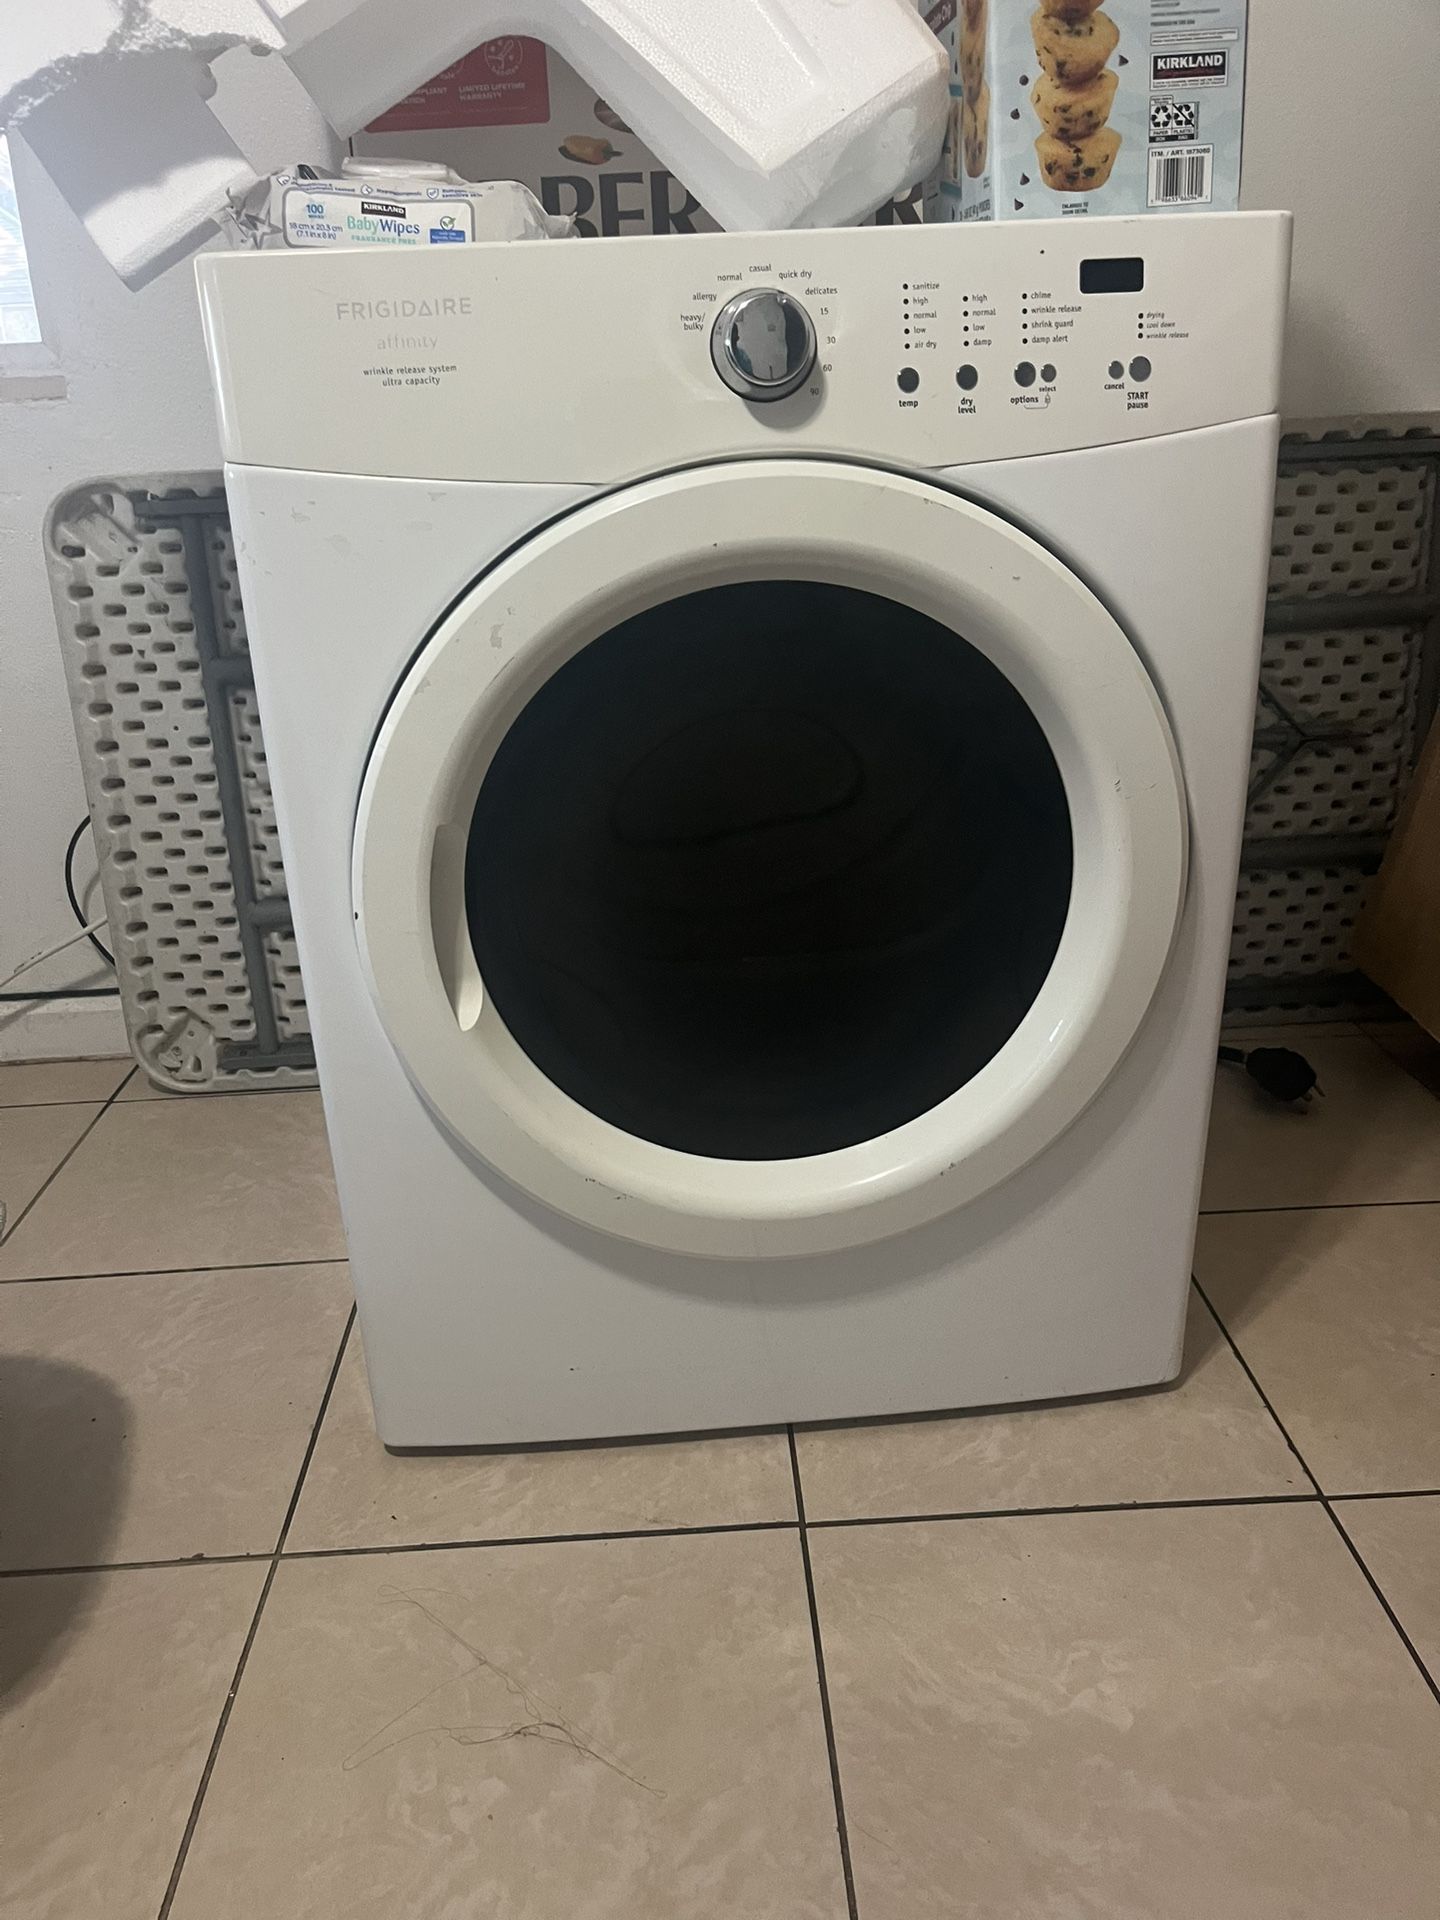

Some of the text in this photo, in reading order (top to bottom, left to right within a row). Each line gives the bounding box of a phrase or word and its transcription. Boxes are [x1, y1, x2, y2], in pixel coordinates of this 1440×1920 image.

[1157, 54, 1223, 70] KIRKLAND
[305, 204, 324, 214] 100
[363, 203, 405, 214] KIRKLAND
[748, 264, 772, 272] casual
[717, 273, 743, 281] normal
[778, 270, 812, 280] quick dry
[912, 282, 940, 290] sanitize
[805, 287, 838, 296] delicates
[1031, 291, 1052, 299] chime
[692, 292, 717, 302] allergy
[912, 296, 928, 306] high
[972, 294, 988, 303] high
[336, 297, 473, 320] FRIGIDAIRE
[820, 307, 829, 315] 15
[972, 308, 997, 316] normal
[1031, 305, 1082, 314] wrinkle release
[680, 312, 706, 323] heavy/
[913, 311, 937, 319] normal
[1146, 311, 1165, 319] drying
[683, 322, 704, 331] bulky
[972, 323, 986, 331] low
[1031, 320, 1074, 330] shrink guard
[913, 326, 927, 334] low
[1031, 334, 1068, 345] damp alert
[1146, 331, 1189, 339] wrinkle release
[377, 334, 439, 351] affinity
[826, 336, 837, 345] 30
[926, 340, 937, 350] dry
[973, 338, 992, 347] damp
[363, 364, 457, 376] wrinkle release system
[822, 364, 833, 372] 60
[382, 376, 441, 387] ultra capacity
[1104, 382, 1125, 391] cancel
[810, 387, 820, 396] 90
[1127, 391, 1149, 401] START
[898, 399, 919, 408] temp
[960, 397, 973, 406] dry
[1010, 395, 1039, 405] options
[957, 406, 977, 414] level
[1126, 401, 1149, 411] pause
